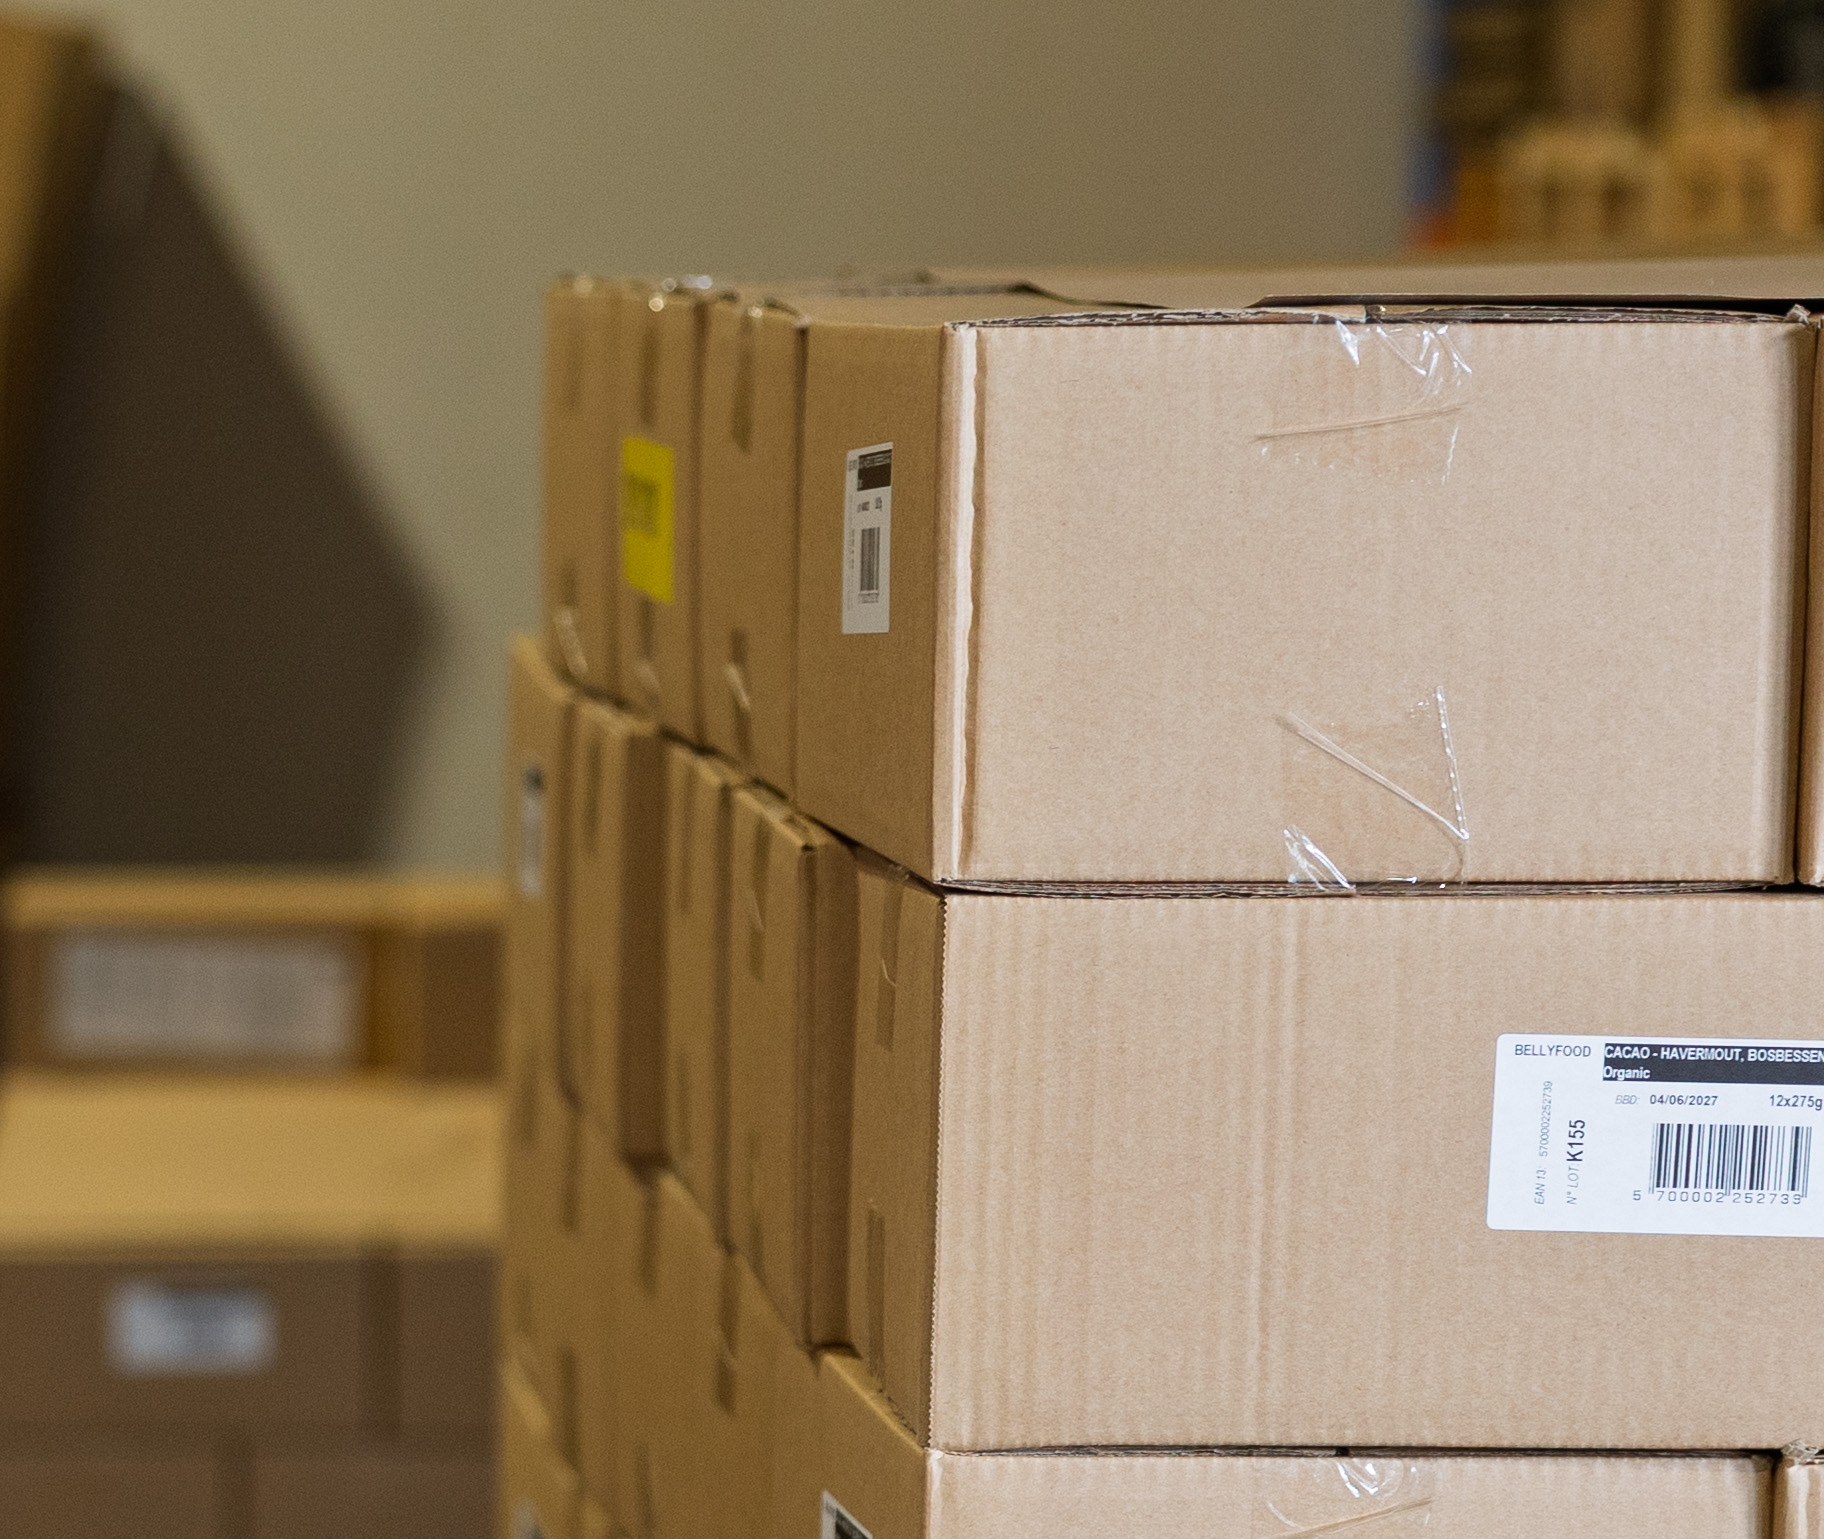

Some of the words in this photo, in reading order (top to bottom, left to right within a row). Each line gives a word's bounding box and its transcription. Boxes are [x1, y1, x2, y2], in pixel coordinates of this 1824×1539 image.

[1514, 1044, 1592, 1057] BELLYFOOD
[1604, 1046, 1651, 1059] CACAO
[1660, 1047, 1745, 1062] HAVERMOUT,
[1603, 1066, 1651, 1081] Organic
[1649, 1094, 1719, 1106] 04/06/2027
[1769, 1094, 1823, 1111] 12x275g
[1539, 1080, 1554, 1157] 5700002252739
[1566, 1119, 1586, 1162] K155
[1534, 1182, 1546, 1205] EAN
[1632, 1190, 1642, 1201] 5
[1656, 1190, 1725, 1203] 700002
